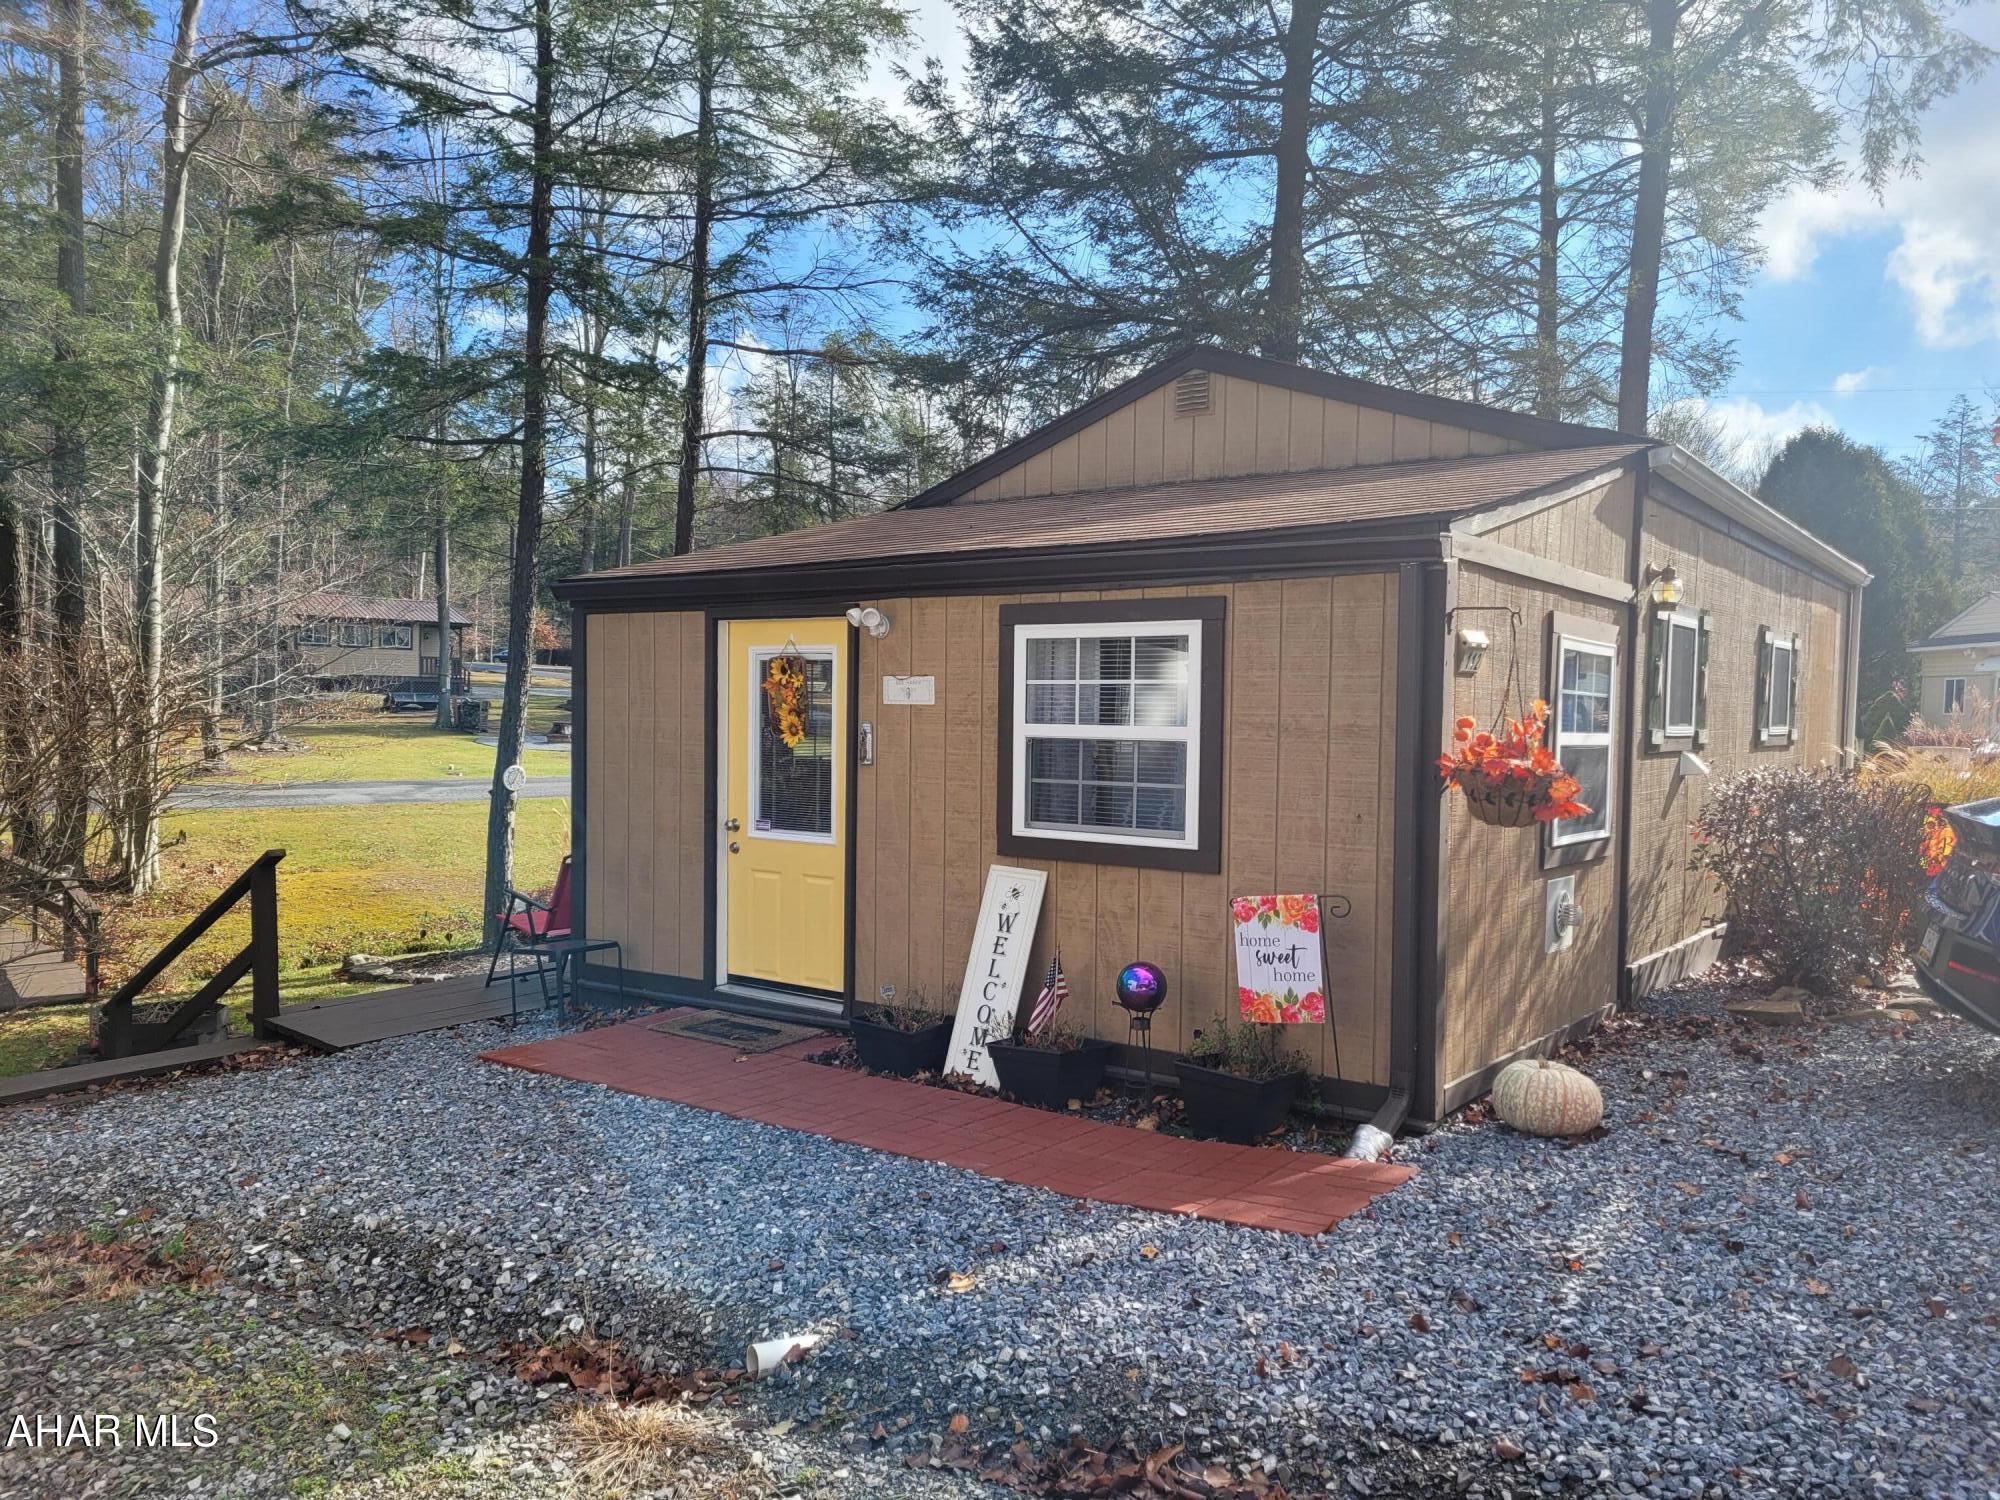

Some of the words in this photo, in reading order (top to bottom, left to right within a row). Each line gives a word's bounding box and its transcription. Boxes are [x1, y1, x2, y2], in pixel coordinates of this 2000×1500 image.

[1240, 932, 1280, 947] home
[1256, 944, 1307, 969] sweet
[1273, 967, 1316, 982] home
[966, 911, 1018, 1071] WELCOME
